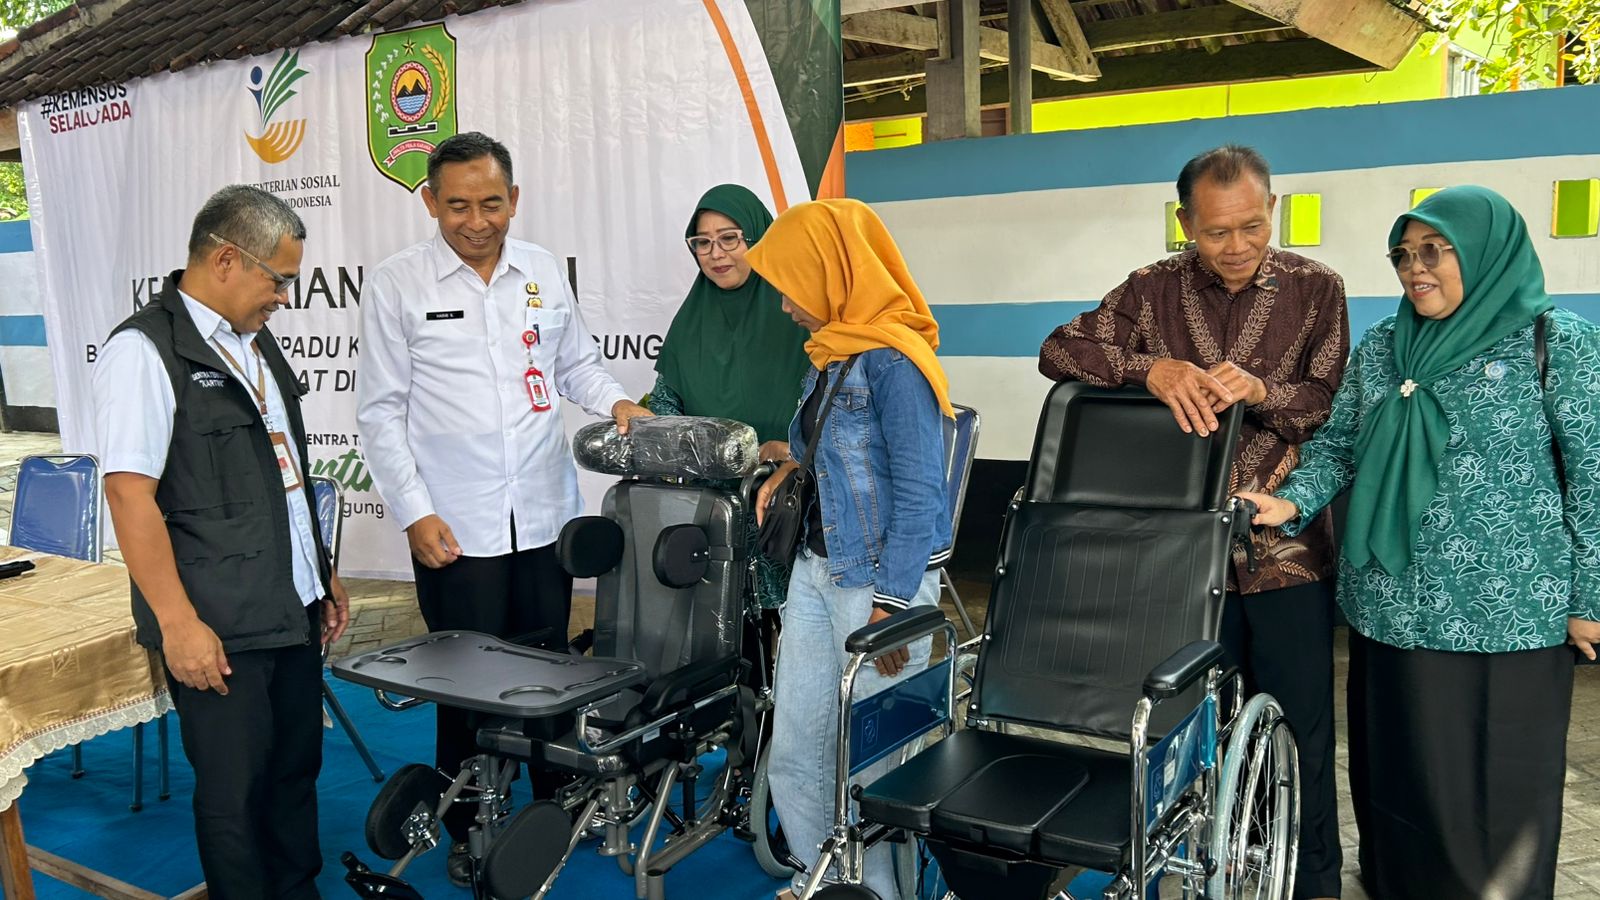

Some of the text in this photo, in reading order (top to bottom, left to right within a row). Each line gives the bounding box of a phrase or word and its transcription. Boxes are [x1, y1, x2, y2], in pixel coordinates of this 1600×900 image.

[300, 175, 340, 189] SOSIAL
[276, 335, 341, 358] PADU
[298, 369, 328, 391] AT
[306, 433, 348, 446] ENTRA
[343, 501, 384, 519] gung
